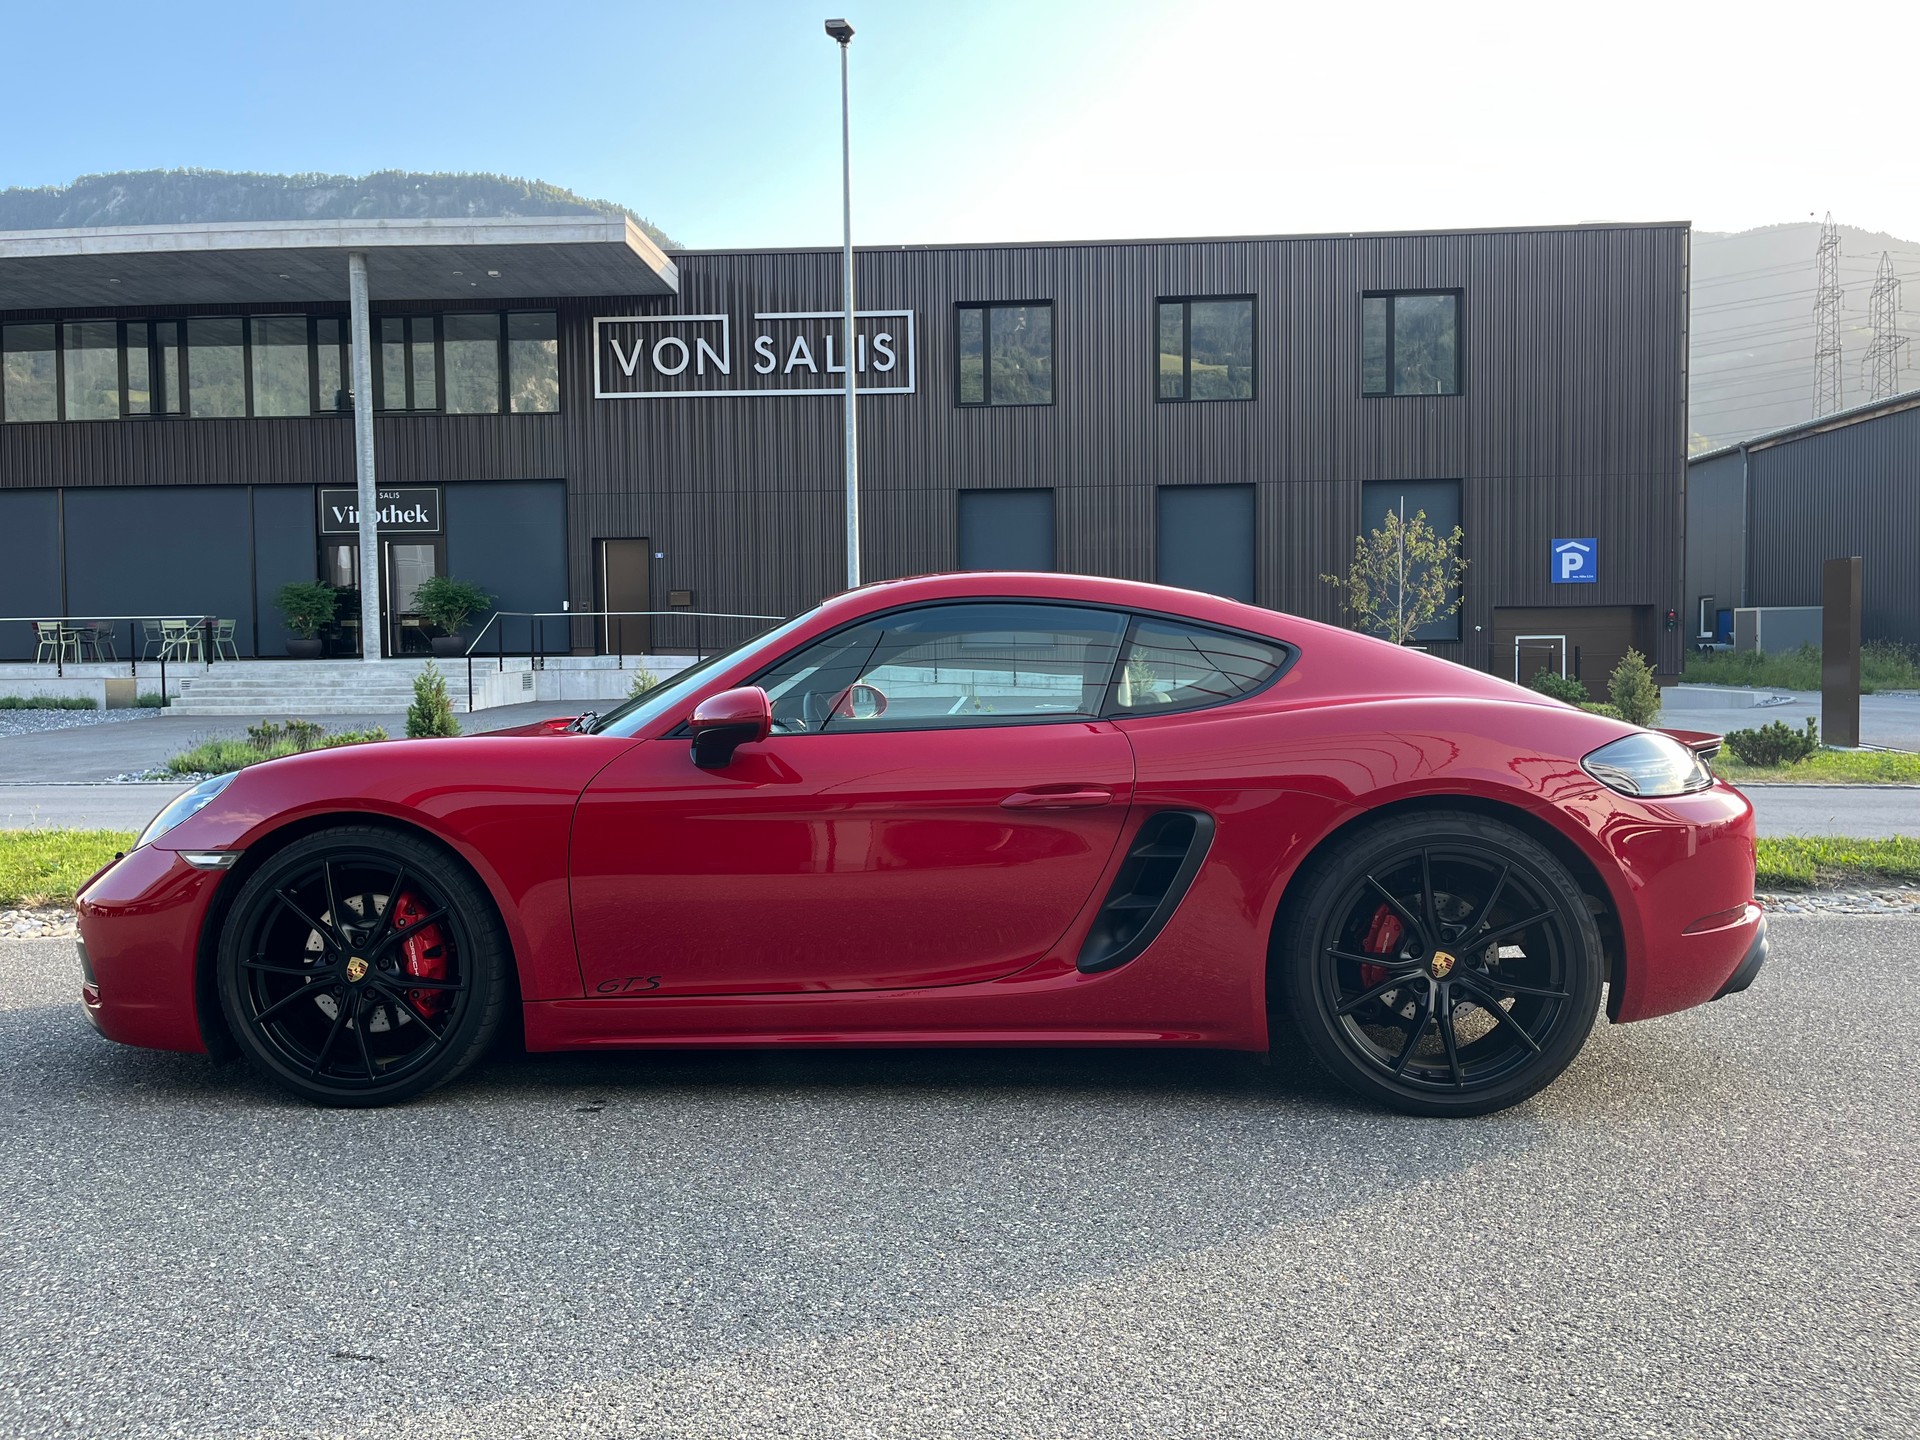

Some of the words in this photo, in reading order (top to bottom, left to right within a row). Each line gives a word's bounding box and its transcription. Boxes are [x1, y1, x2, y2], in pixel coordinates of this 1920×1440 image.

[610, 337, 730, 376] VON
[753, 332, 896, 374] SALIS
[332, 504, 429, 523] Vithek
[1562, 552, 1584, 579] P
[409, 936, 419, 976] ORSCH
[596, 975, 662, 993] GTS
